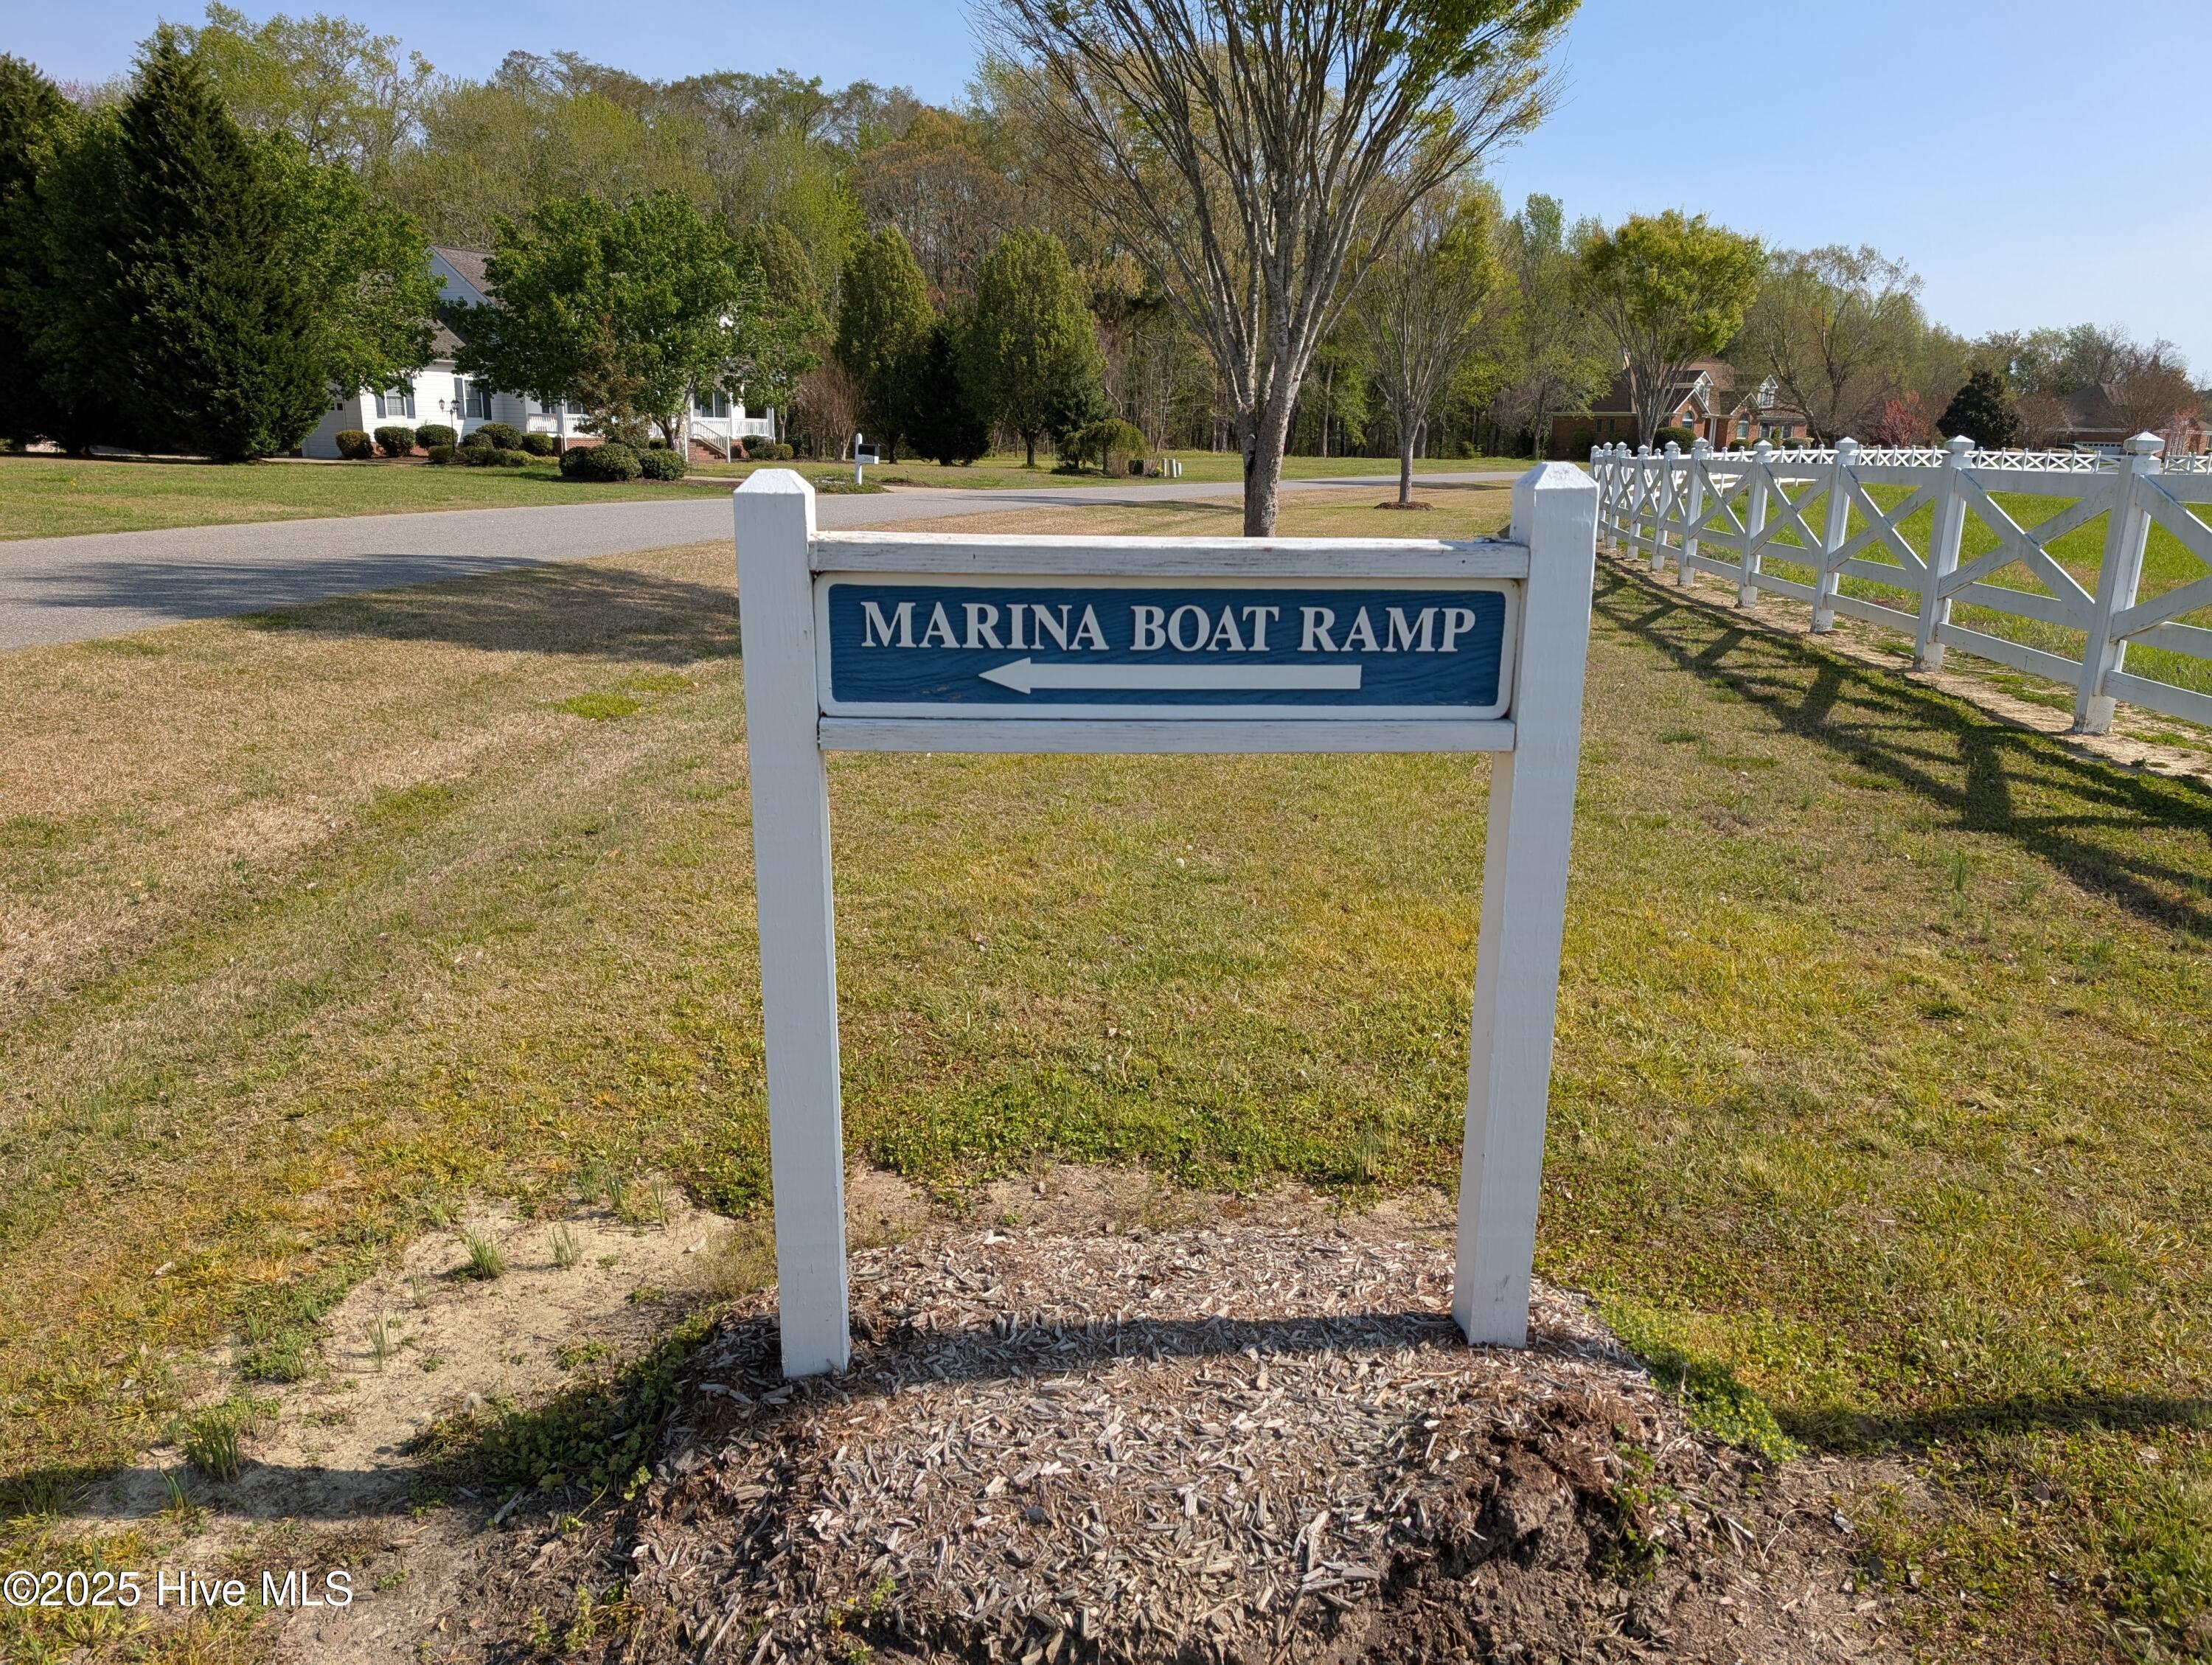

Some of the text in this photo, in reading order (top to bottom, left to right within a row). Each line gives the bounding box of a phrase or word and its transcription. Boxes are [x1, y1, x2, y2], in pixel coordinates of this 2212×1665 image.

[860, 600, 1477, 654] MARINA BOAT RAMP
